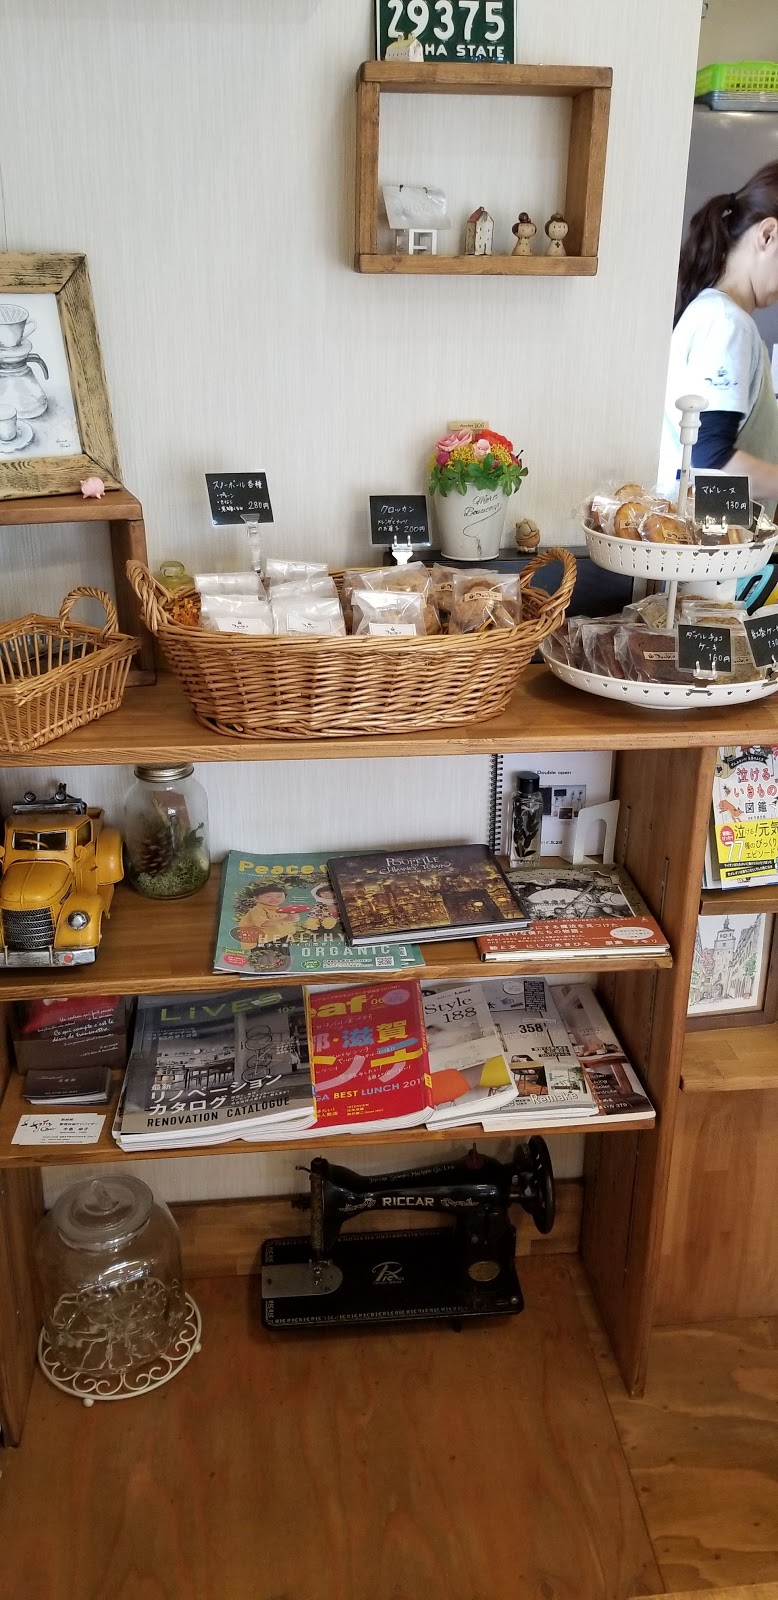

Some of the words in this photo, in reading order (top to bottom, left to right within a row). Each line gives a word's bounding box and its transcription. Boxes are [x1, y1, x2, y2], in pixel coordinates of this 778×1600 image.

[387, 0, 505, 41] 29375
[456, 45, 505, 58] STATE
[701, 485, 736, 495] マドレーヌ
[248, 501, 270, 510] 280円
[380, 505, 415, 514] クロッカン
[725, 501, 747, 510] 130円
[403, 525, 426, 533] 200円
[698, 642, 717, 651] ケーキ
[708, 653, 730, 662] 160円
[736, 767, 771, 783] 泣ける
[733, 783, 778, 799] いきもの
[745, 801, 768, 813] 図鑑
[239, 860, 315, 875] Peace
[258, 932, 346, 943] HEALTHY
[301, 945, 391, 956] ORGANIC
[424, 997, 473, 1015] Style
[443, 1007, 477, 1024] 188
[518, 1023, 544, 1033] 358
[151, 1074, 282, 1104] リノベーション
[333, 1090, 359, 1099] BEST
[361, 1083, 400, 1096] LUNCH
[530, 1092, 579, 1104] Remake
[149, 1094, 228, 1116] カタログ
[147, 1111, 218, 1127] RENOVATION
[226, 1097, 290, 1118] CATALOGUE
[382, 1196, 435, 1207] RICCAR
